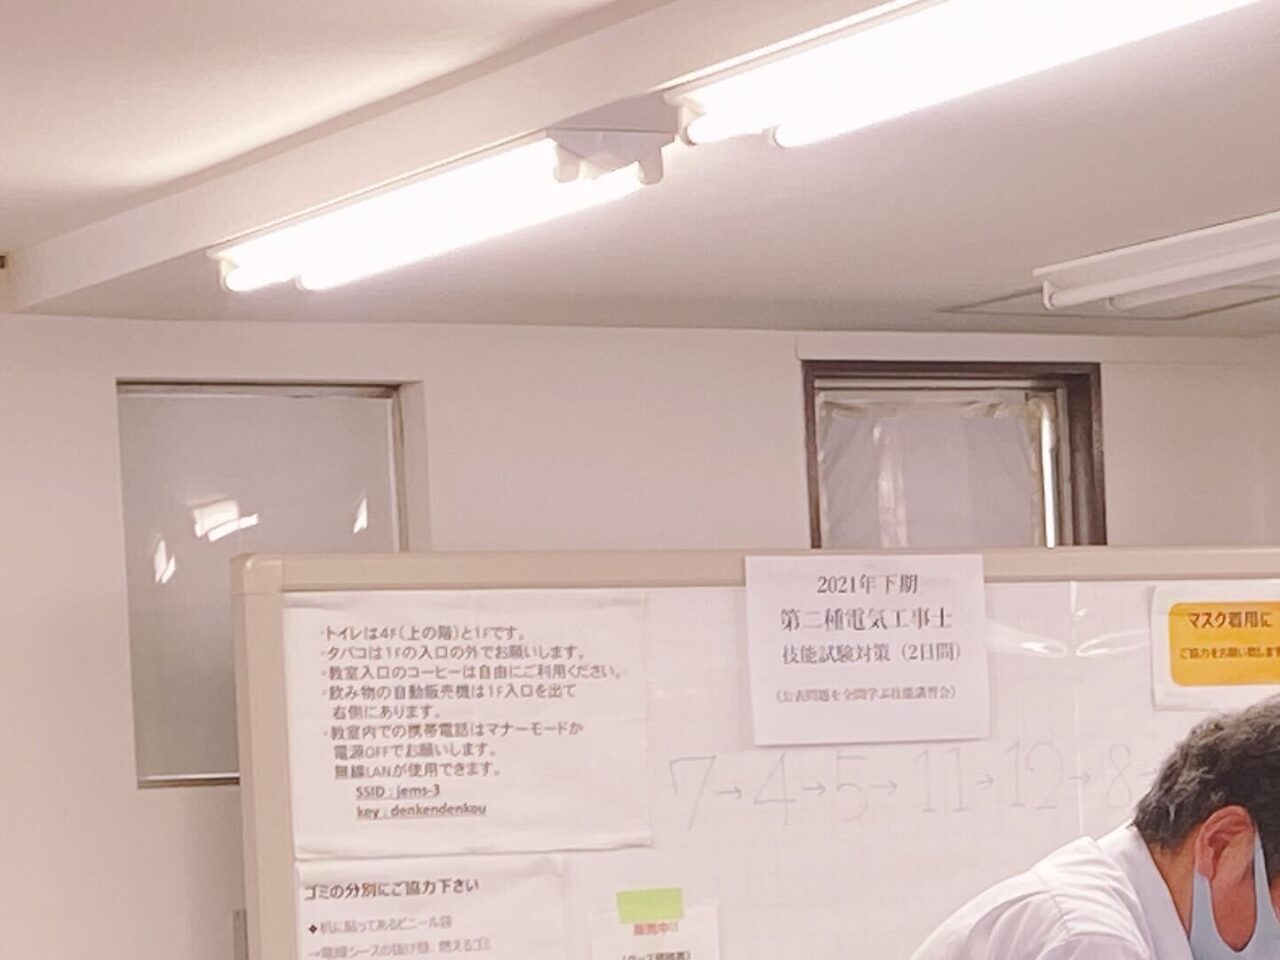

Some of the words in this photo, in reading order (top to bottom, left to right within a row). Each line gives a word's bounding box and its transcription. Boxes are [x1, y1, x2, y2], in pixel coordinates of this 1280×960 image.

[816, 574, 919, 595] 2021年下期
[780, 606, 953, 632] 第二種電気工事士
[1187, 611, 1273, 629] マスク着用に
[669, 755, 717, 832] 7
[753, 753, 799, 827] 4
[836, 750, 869, 823] 5
[914, 746, 970, 813] 11
[1106, 743, 1133, 812] 8
[304, 879, 479, 901] ゴミの分別にご協力下さい
